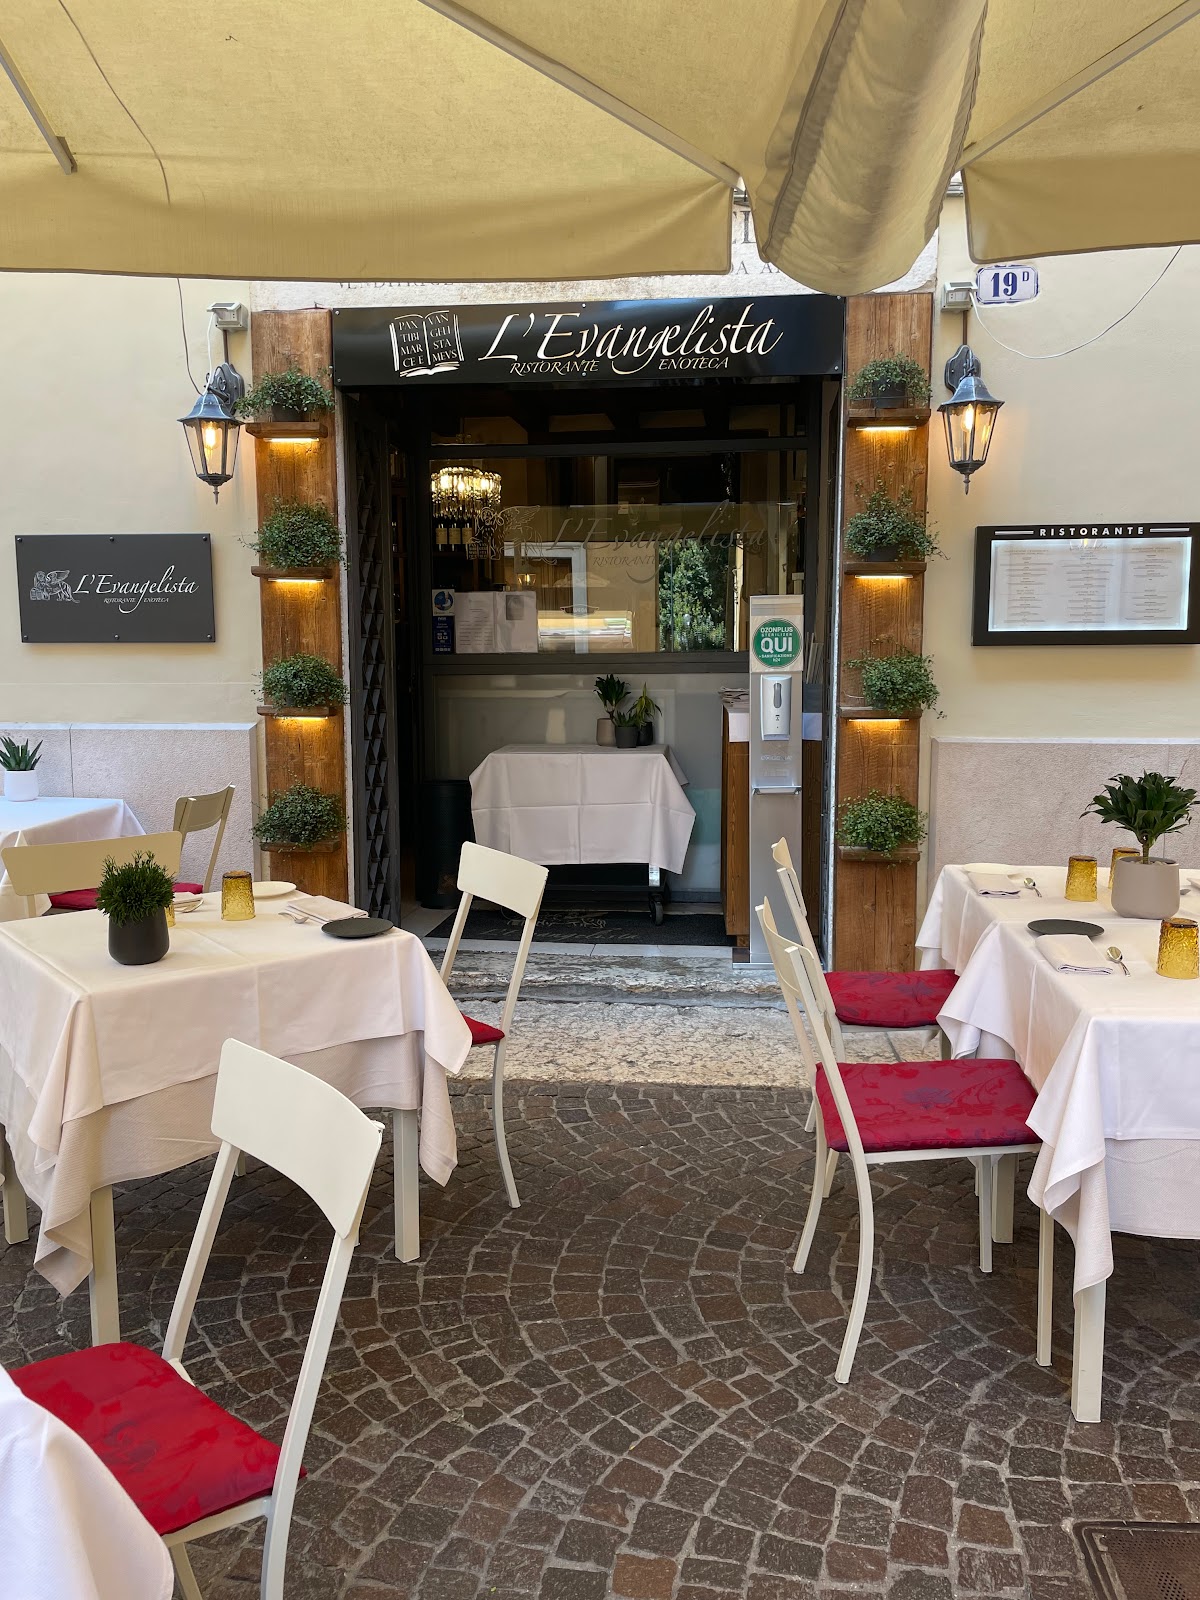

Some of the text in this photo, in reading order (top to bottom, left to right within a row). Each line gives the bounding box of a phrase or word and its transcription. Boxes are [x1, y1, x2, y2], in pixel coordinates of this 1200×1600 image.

[428, 313, 449, 325] VAN
[399, 320, 418, 331] PAX
[400, 332, 420, 342] TIBI
[477, 303, 785, 376] L'Evangelista
[401, 344, 424, 356] MAR
[433, 338, 452, 350] STA
[432, 349, 458, 362] MEVS
[509, 355, 730, 377] RISTORANTE ENOTECA
[1039, 526, 1145, 537] RISTORANTE
[550, 498, 768, 584] L'Evangelista
[72, 564, 200, 614] L'Evangelista
[760, 637, 792, 654] QUI
